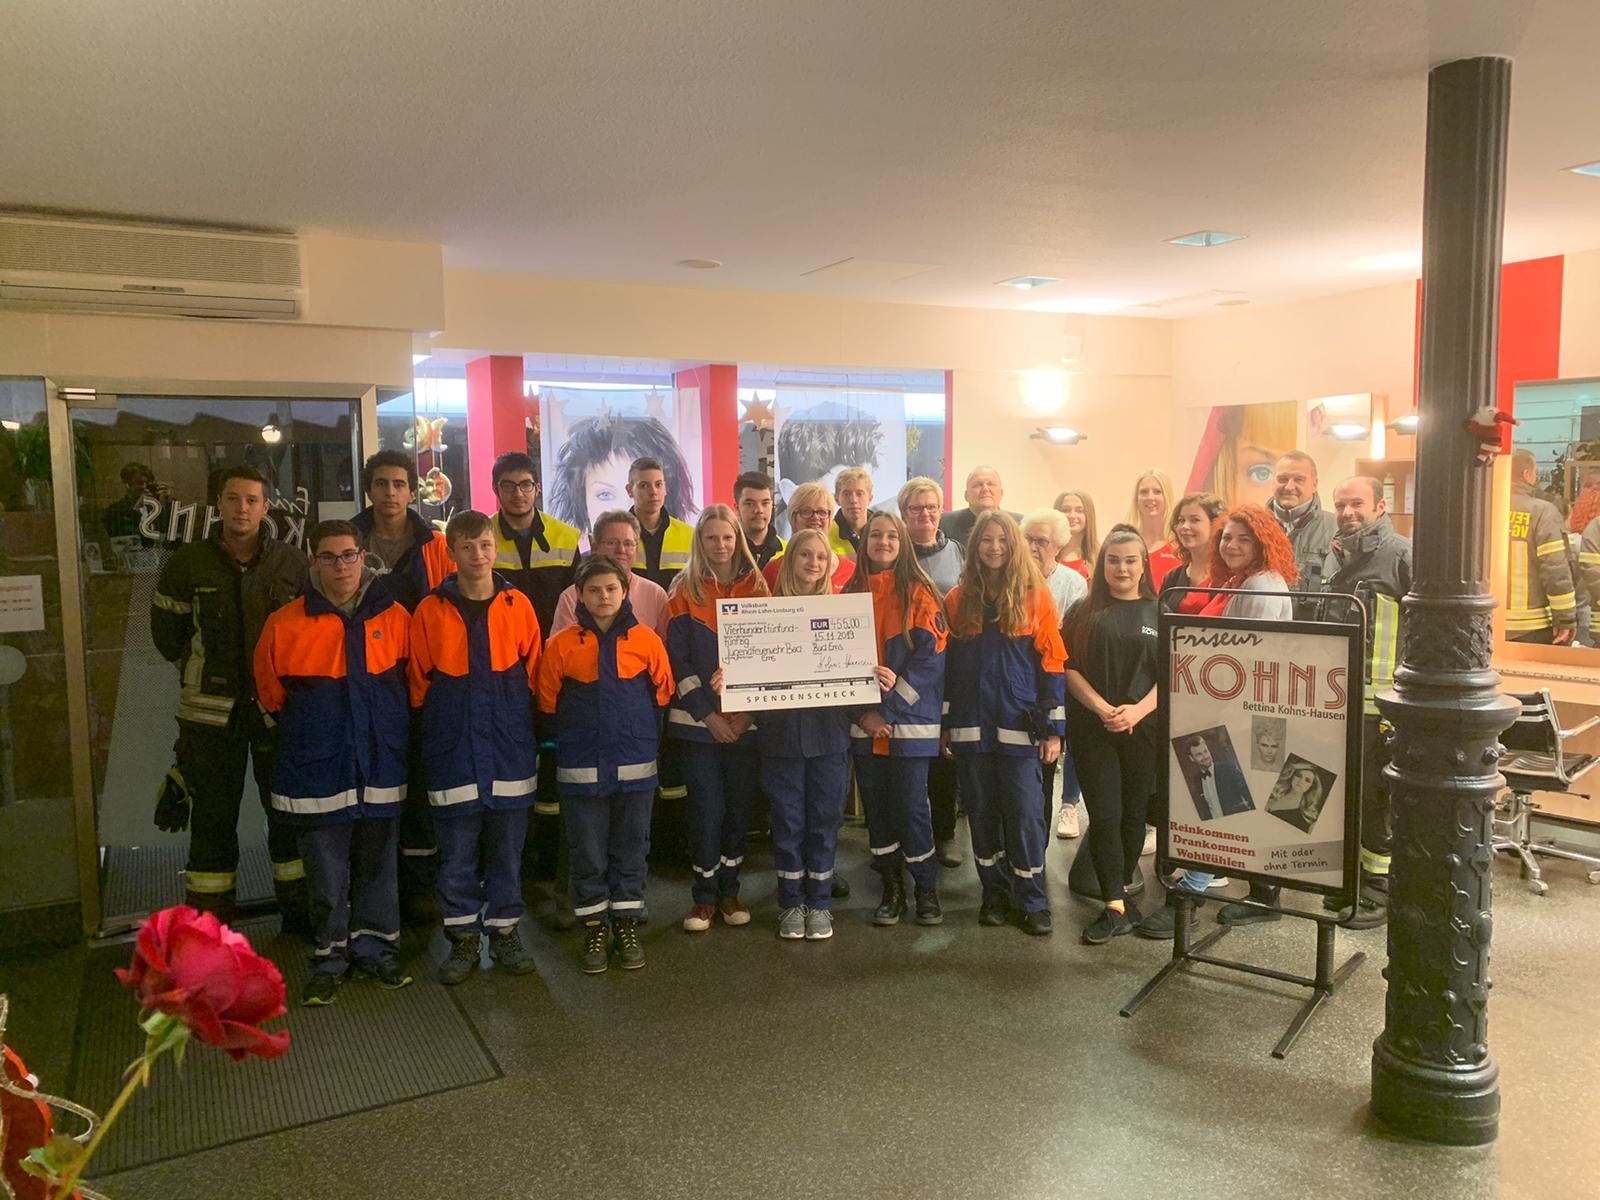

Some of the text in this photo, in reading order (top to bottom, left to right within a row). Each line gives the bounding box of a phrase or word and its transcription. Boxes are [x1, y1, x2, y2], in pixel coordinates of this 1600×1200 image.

[812, 621, 828, 629] EUR
[812, 642, 844, 651] Bad Ems
[1171, 626, 1263, 651] Friseur
[785, 642, 802, 655] Bad
[1170, 653, 1346, 710] KOHNS
[746, 690, 856, 703] SPENDENSCHECK
[1242, 701, 1346, 720] Bettina Kohns-Hausen
[1169, 821, 1250, 843] Reinkommen
[1172, 834, 1256, 857] Drankommen
[1270, 848, 1315, 859] Mit oder
[1175, 848, 1246, 869] Wohlfühlen
[1263, 858, 1329, 872] ohne Termin
